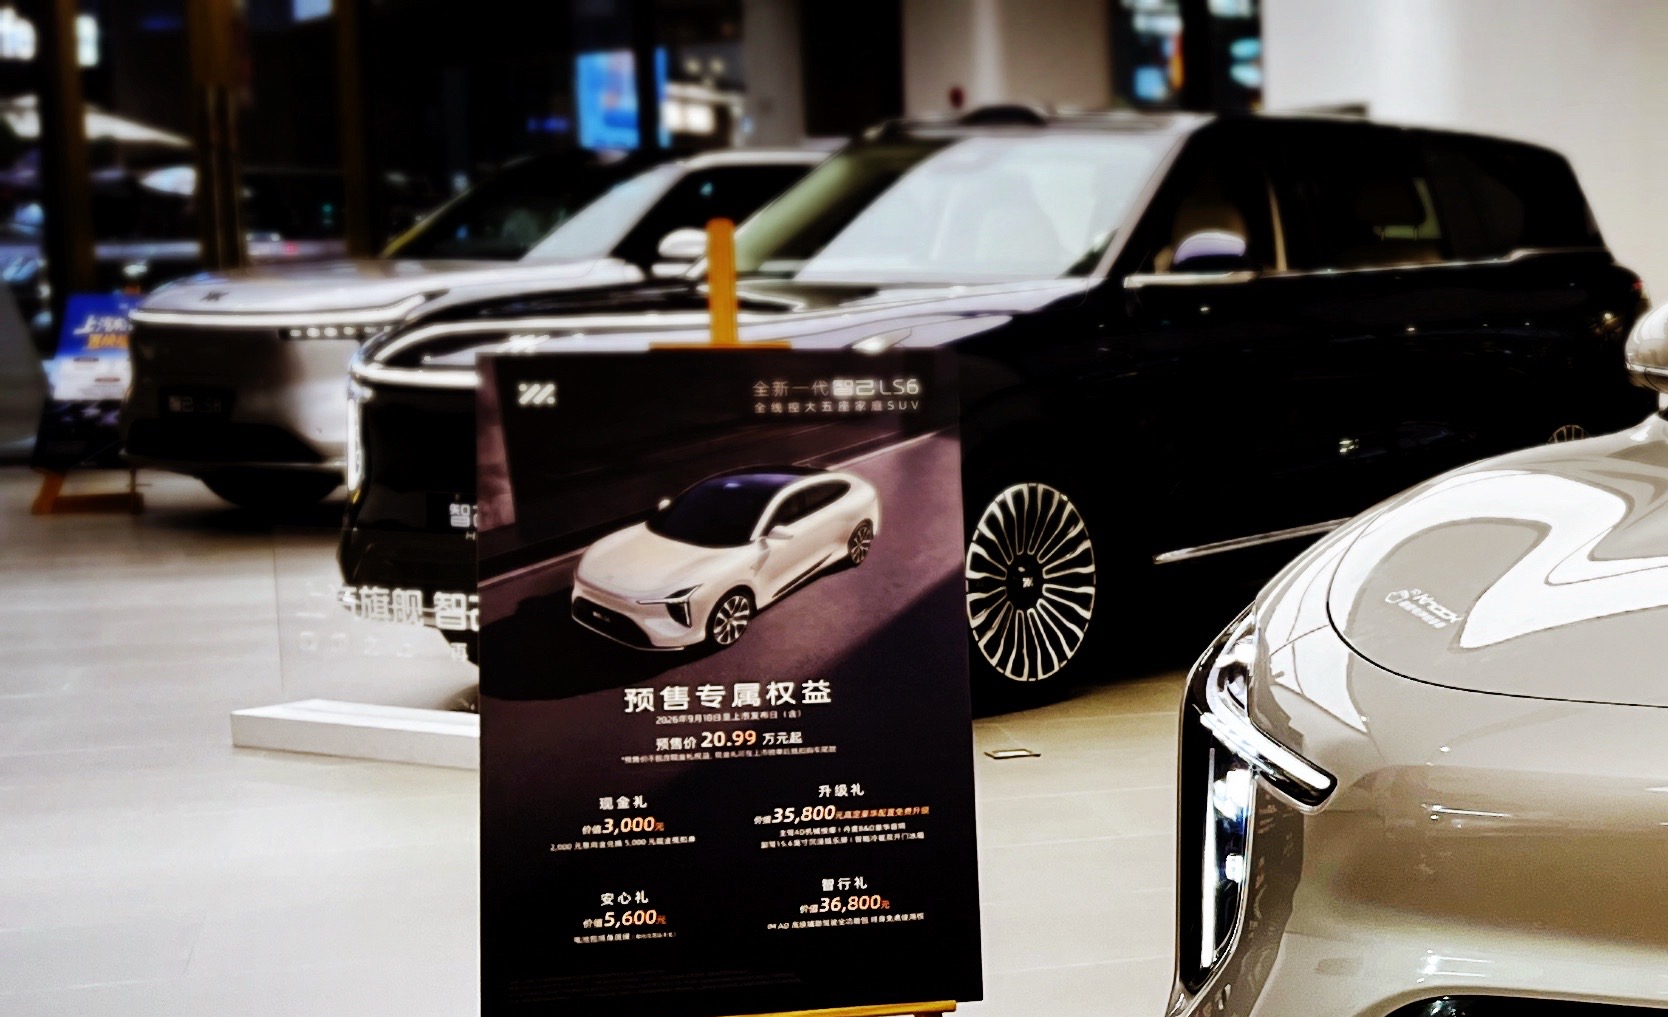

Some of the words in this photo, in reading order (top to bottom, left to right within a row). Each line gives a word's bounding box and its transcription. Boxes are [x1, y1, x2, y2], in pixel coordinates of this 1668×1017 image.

[624, 680, 831, 712] 预售专属权益
[656, 737, 697, 751] 预售价
[701, 730, 756, 747] 20.99
[763, 732, 802, 745] 万元起
[819, 783, 864, 797] 升级礼
[599, 795, 647, 810] 现金礼
[822, 877, 867, 891] 智行礼
[601, 890, 648, 906] 安心礼
